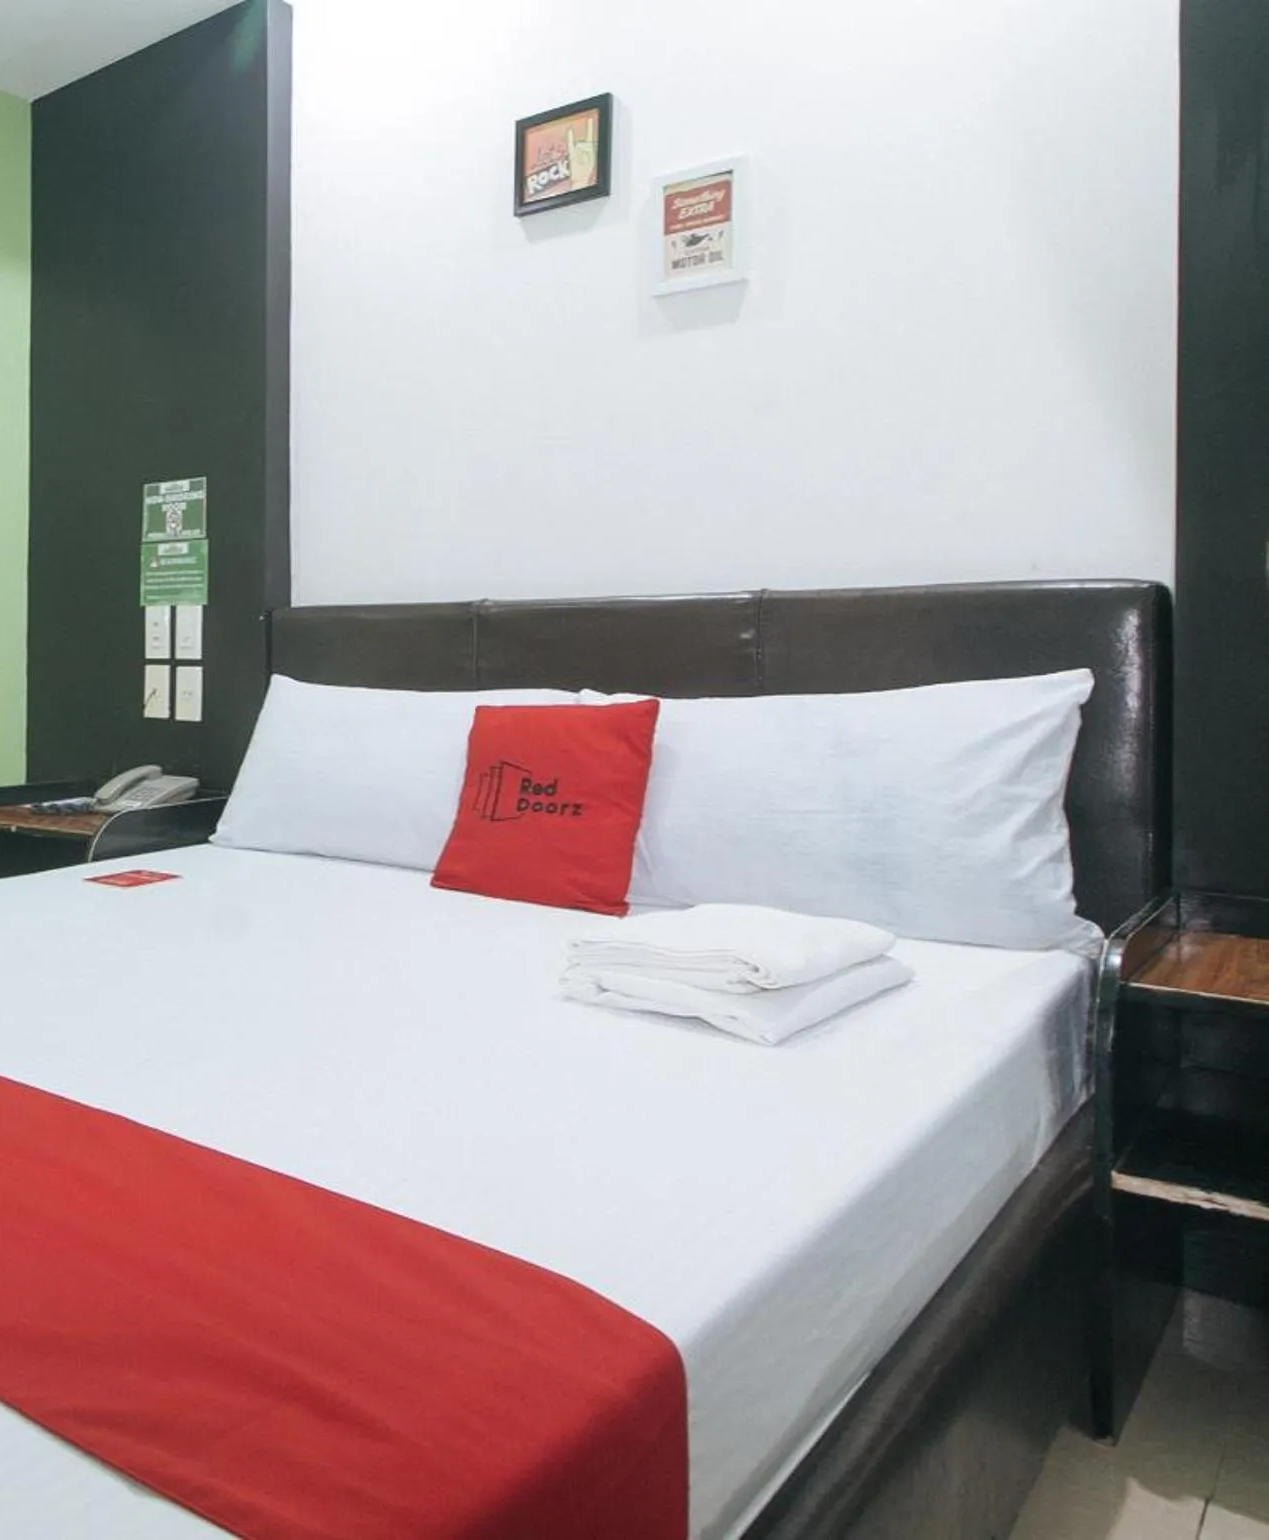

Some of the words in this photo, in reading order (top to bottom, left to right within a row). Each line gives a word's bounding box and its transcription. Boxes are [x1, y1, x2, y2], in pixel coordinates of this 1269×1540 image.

[526, 159, 570, 194] ROCK
[520, 777, 558, 796] Red
[516, 798, 583, 816] Doorz
